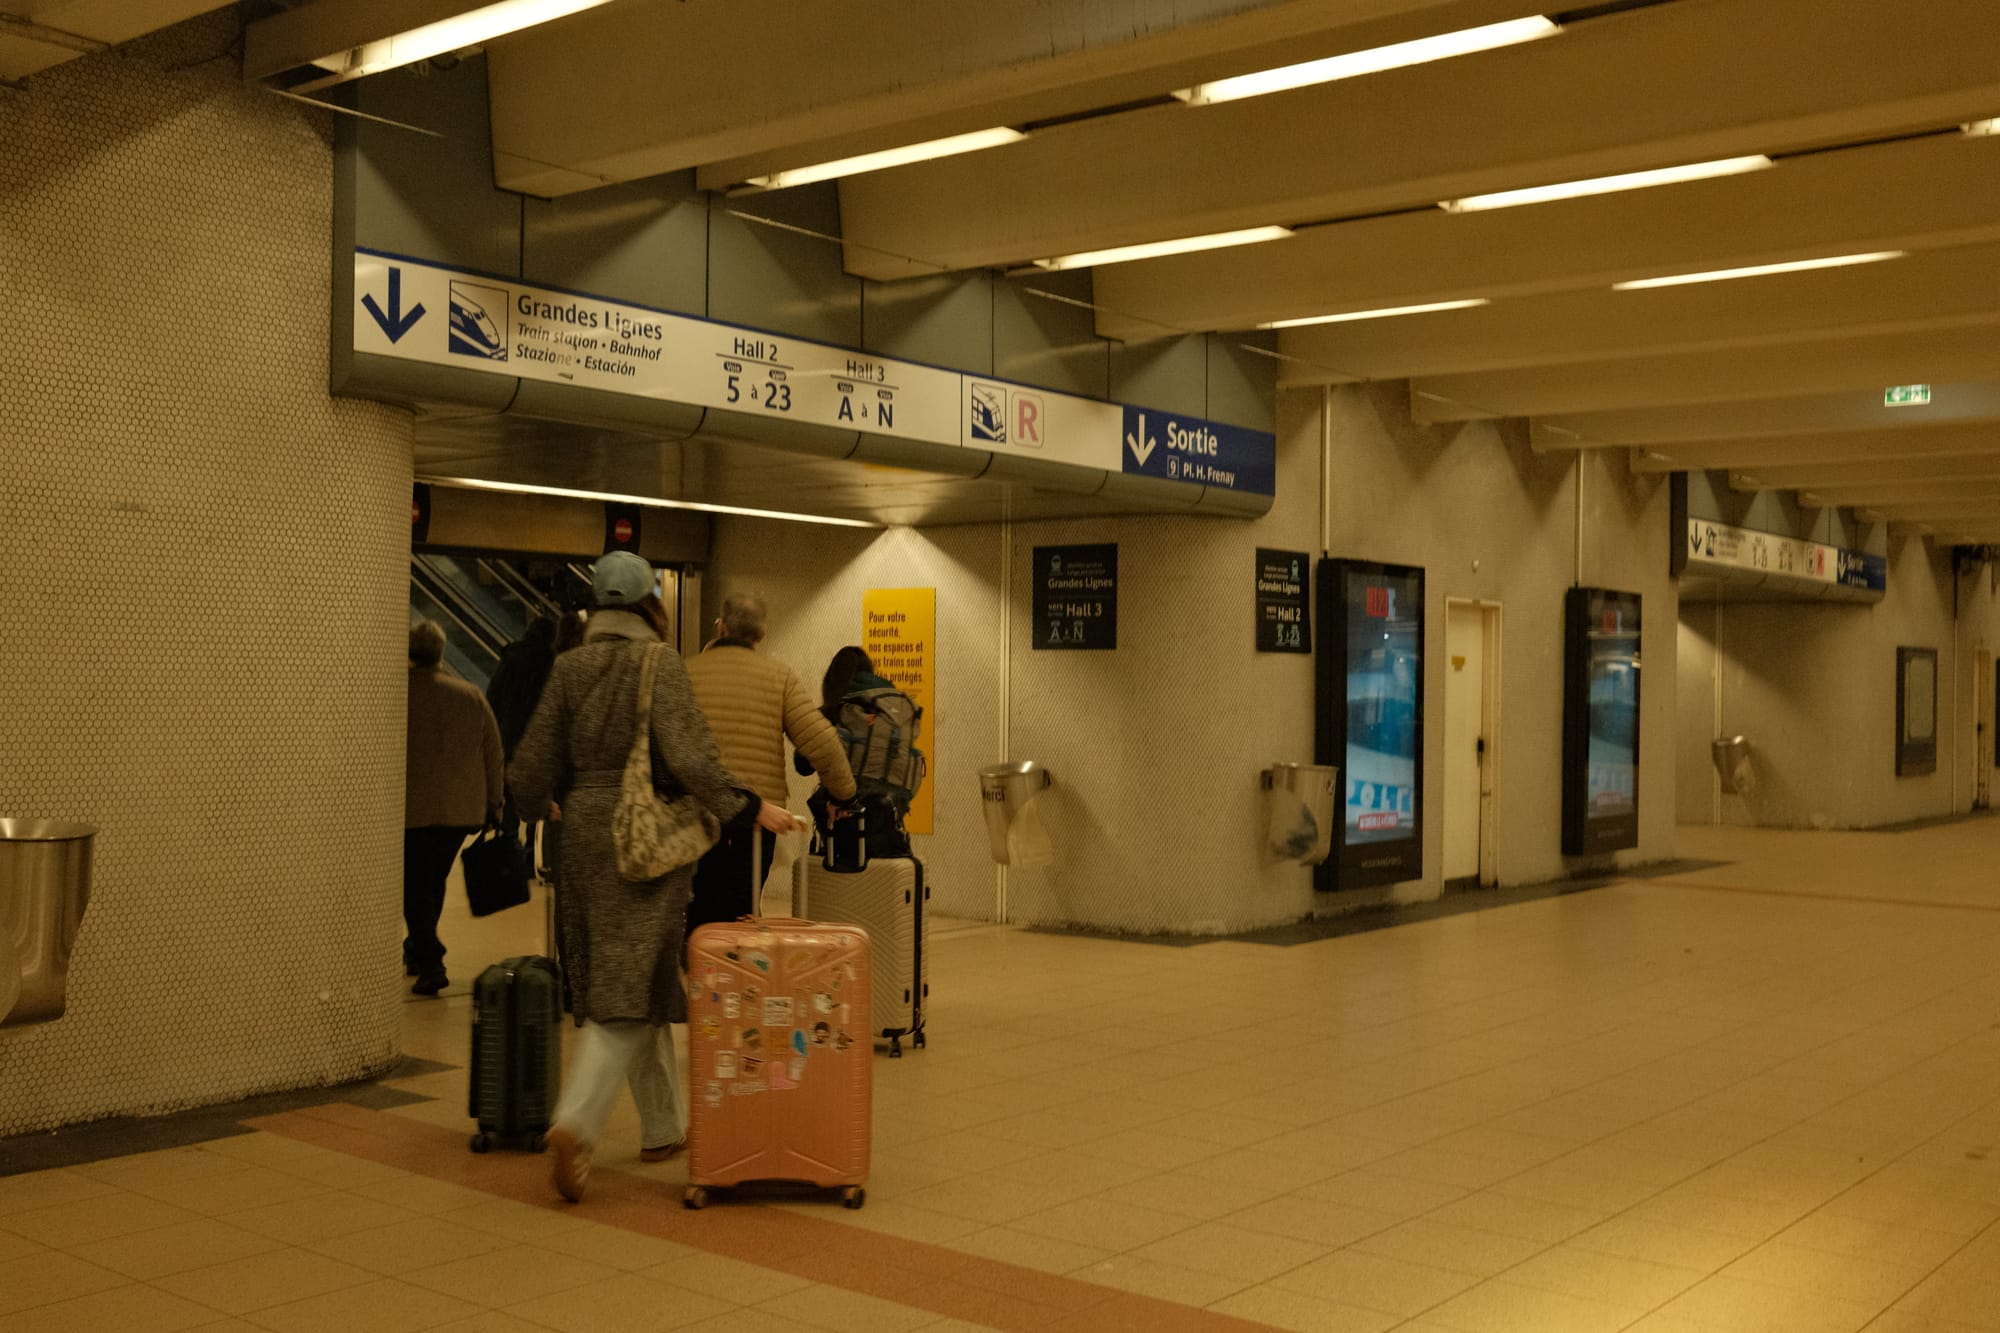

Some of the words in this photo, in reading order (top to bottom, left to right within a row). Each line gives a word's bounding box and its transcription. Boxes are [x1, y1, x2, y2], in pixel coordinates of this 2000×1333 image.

[517, 295, 598, 328] Grandes
[604, 310, 663, 340] Lignes
[517, 322, 550, 342] Train
[553, 331, 598, 351] station
[515, 343, 572, 365] Stazione
[609, 339, 662, 361] Bahnhof
[734, 337, 764, 360] Hall
[769, 344, 778, 362] 2
[584, 355, 636, 377] Estación
[846, 359, 873, 380] Hall
[877, 365, 885, 382] 3
[727, 376, 740, 403] 5
[751, 384, 758, 400] à
[764, 382, 791, 411] 23
[838, 395, 854, 422] A
[878, 402, 893, 429] N
[1018, 399, 1039, 442] R
[1167, 421, 1218, 457] Sortie
[1183, 462, 1195, 477] Pl.
[1196, 463, 1206, 481] H.
[1207, 465, 1235, 487] Frenay
[868, 611, 885, 623] Pour
[887, 611, 906, 623] votre
[1066, 603, 1091, 617] Hall
[1095, 602, 1102, 617] 3
[1278, 606, 1294, 621] Hall
[1296, 607, 1301, 622] 2
[883, 643, 913, 656] espaces
[915, 640, 923, 652] et
[883, 656, 905, 668] trains
[907, 657, 922, 668] sont
